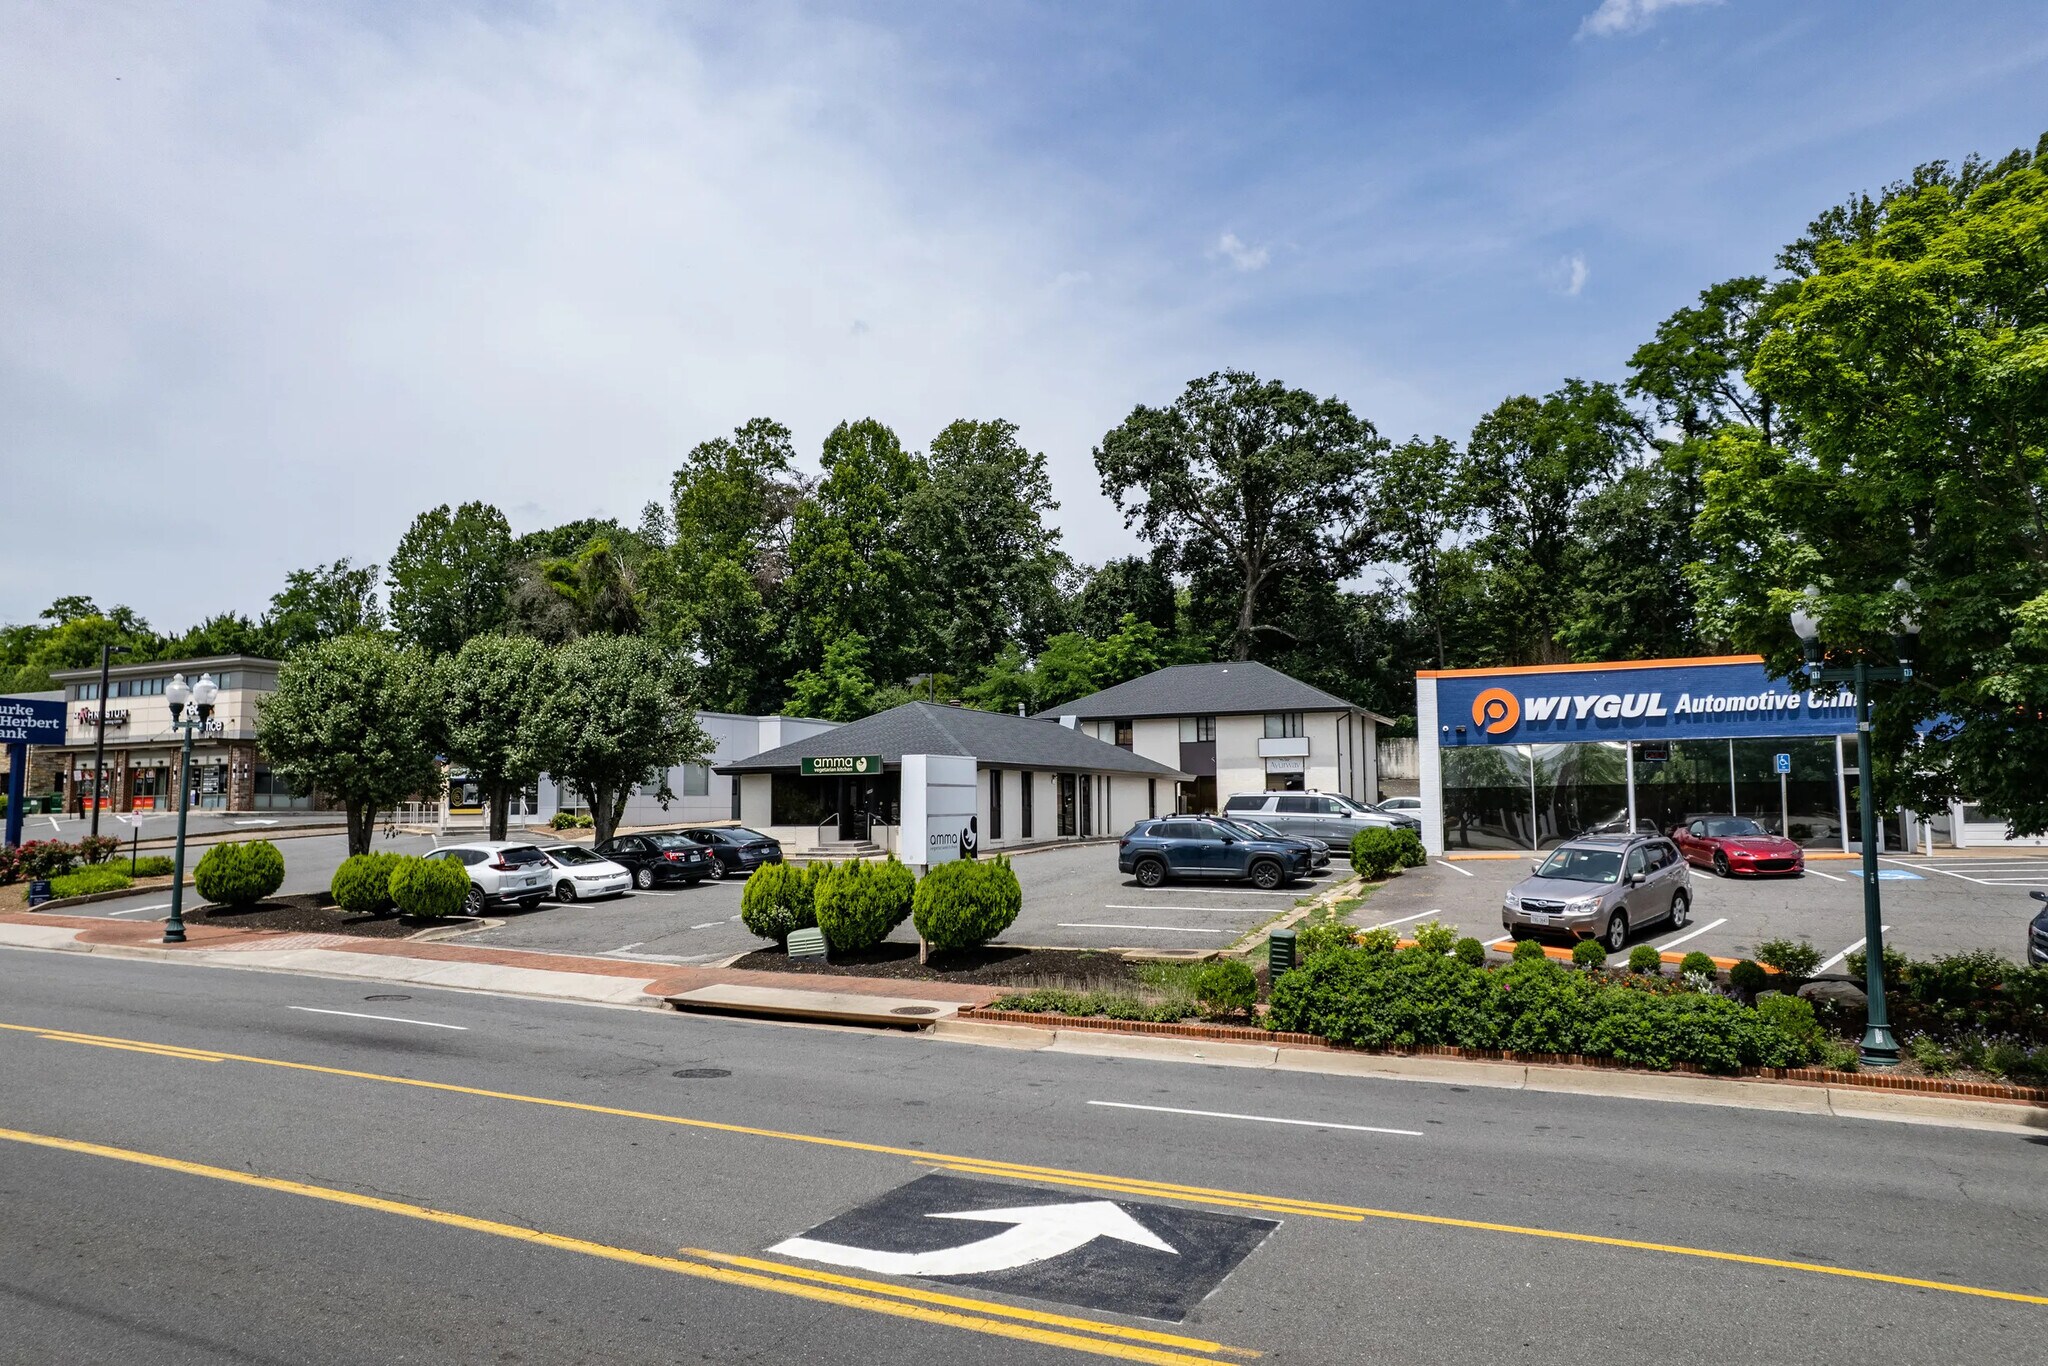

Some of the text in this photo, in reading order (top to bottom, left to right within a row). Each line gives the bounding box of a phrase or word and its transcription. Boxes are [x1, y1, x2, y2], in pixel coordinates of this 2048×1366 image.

[0, 703, 34, 716] urke
[1524, 692, 1668, 721] WIYGUL
[1673, 689, 1801, 714] Automotive
[0, 716, 60, 729] Herbert
[0, 728, 28, 739] ank
[813, 757, 853, 768] amma
[929, 833, 958, 846] amma
